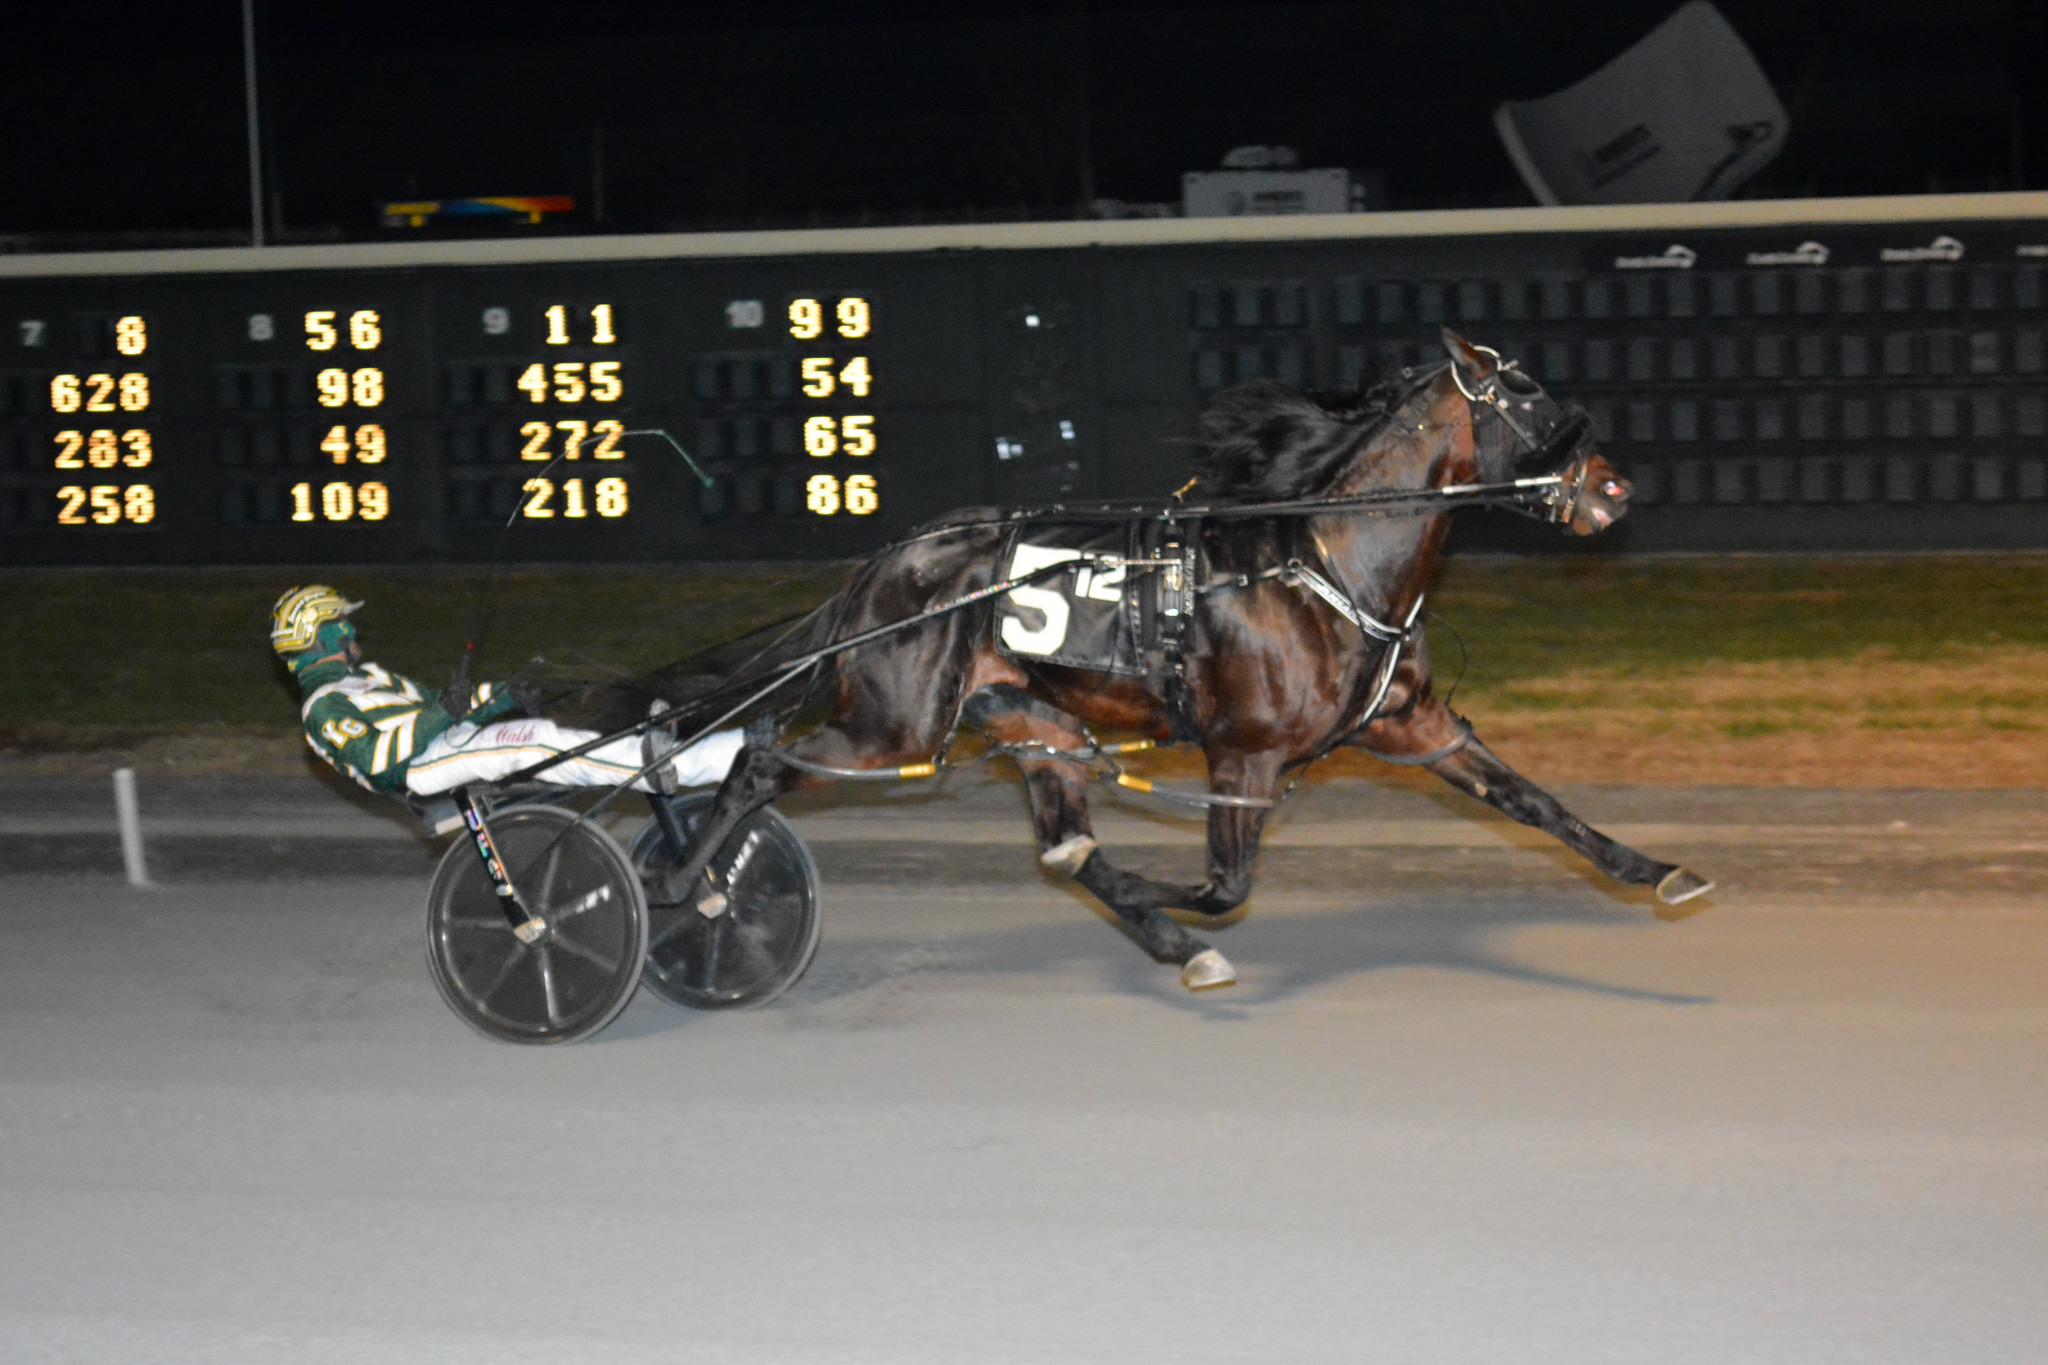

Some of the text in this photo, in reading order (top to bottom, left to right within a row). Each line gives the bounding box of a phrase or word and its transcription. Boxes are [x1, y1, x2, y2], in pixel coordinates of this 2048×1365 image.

[19, 319, 45, 346] 7
[116, 316, 147, 356] 8
[248, 313, 274, 341] 8
[482, 307, 511, 335] 9
[50, 373, 150, 413] 628
[316, 367, 385, 408] 98
[517, 360, 623, 403] 455
[801, 356, 873, 398] 54
[53, 428, 153, 469] 283
[320, 424, 387, 464] 49
[520, 419, 626, 461] 272
[803, 415, 877, 457] 65
[56, 485, 156, 525] 258
[290, 481, 390, 522] 109
[522, 477, 629, 518] 218
[806, 474, 879, 516] 86
[1074, 552, 1127, 602] 12
[1001, 543, 1081, 656] 5
